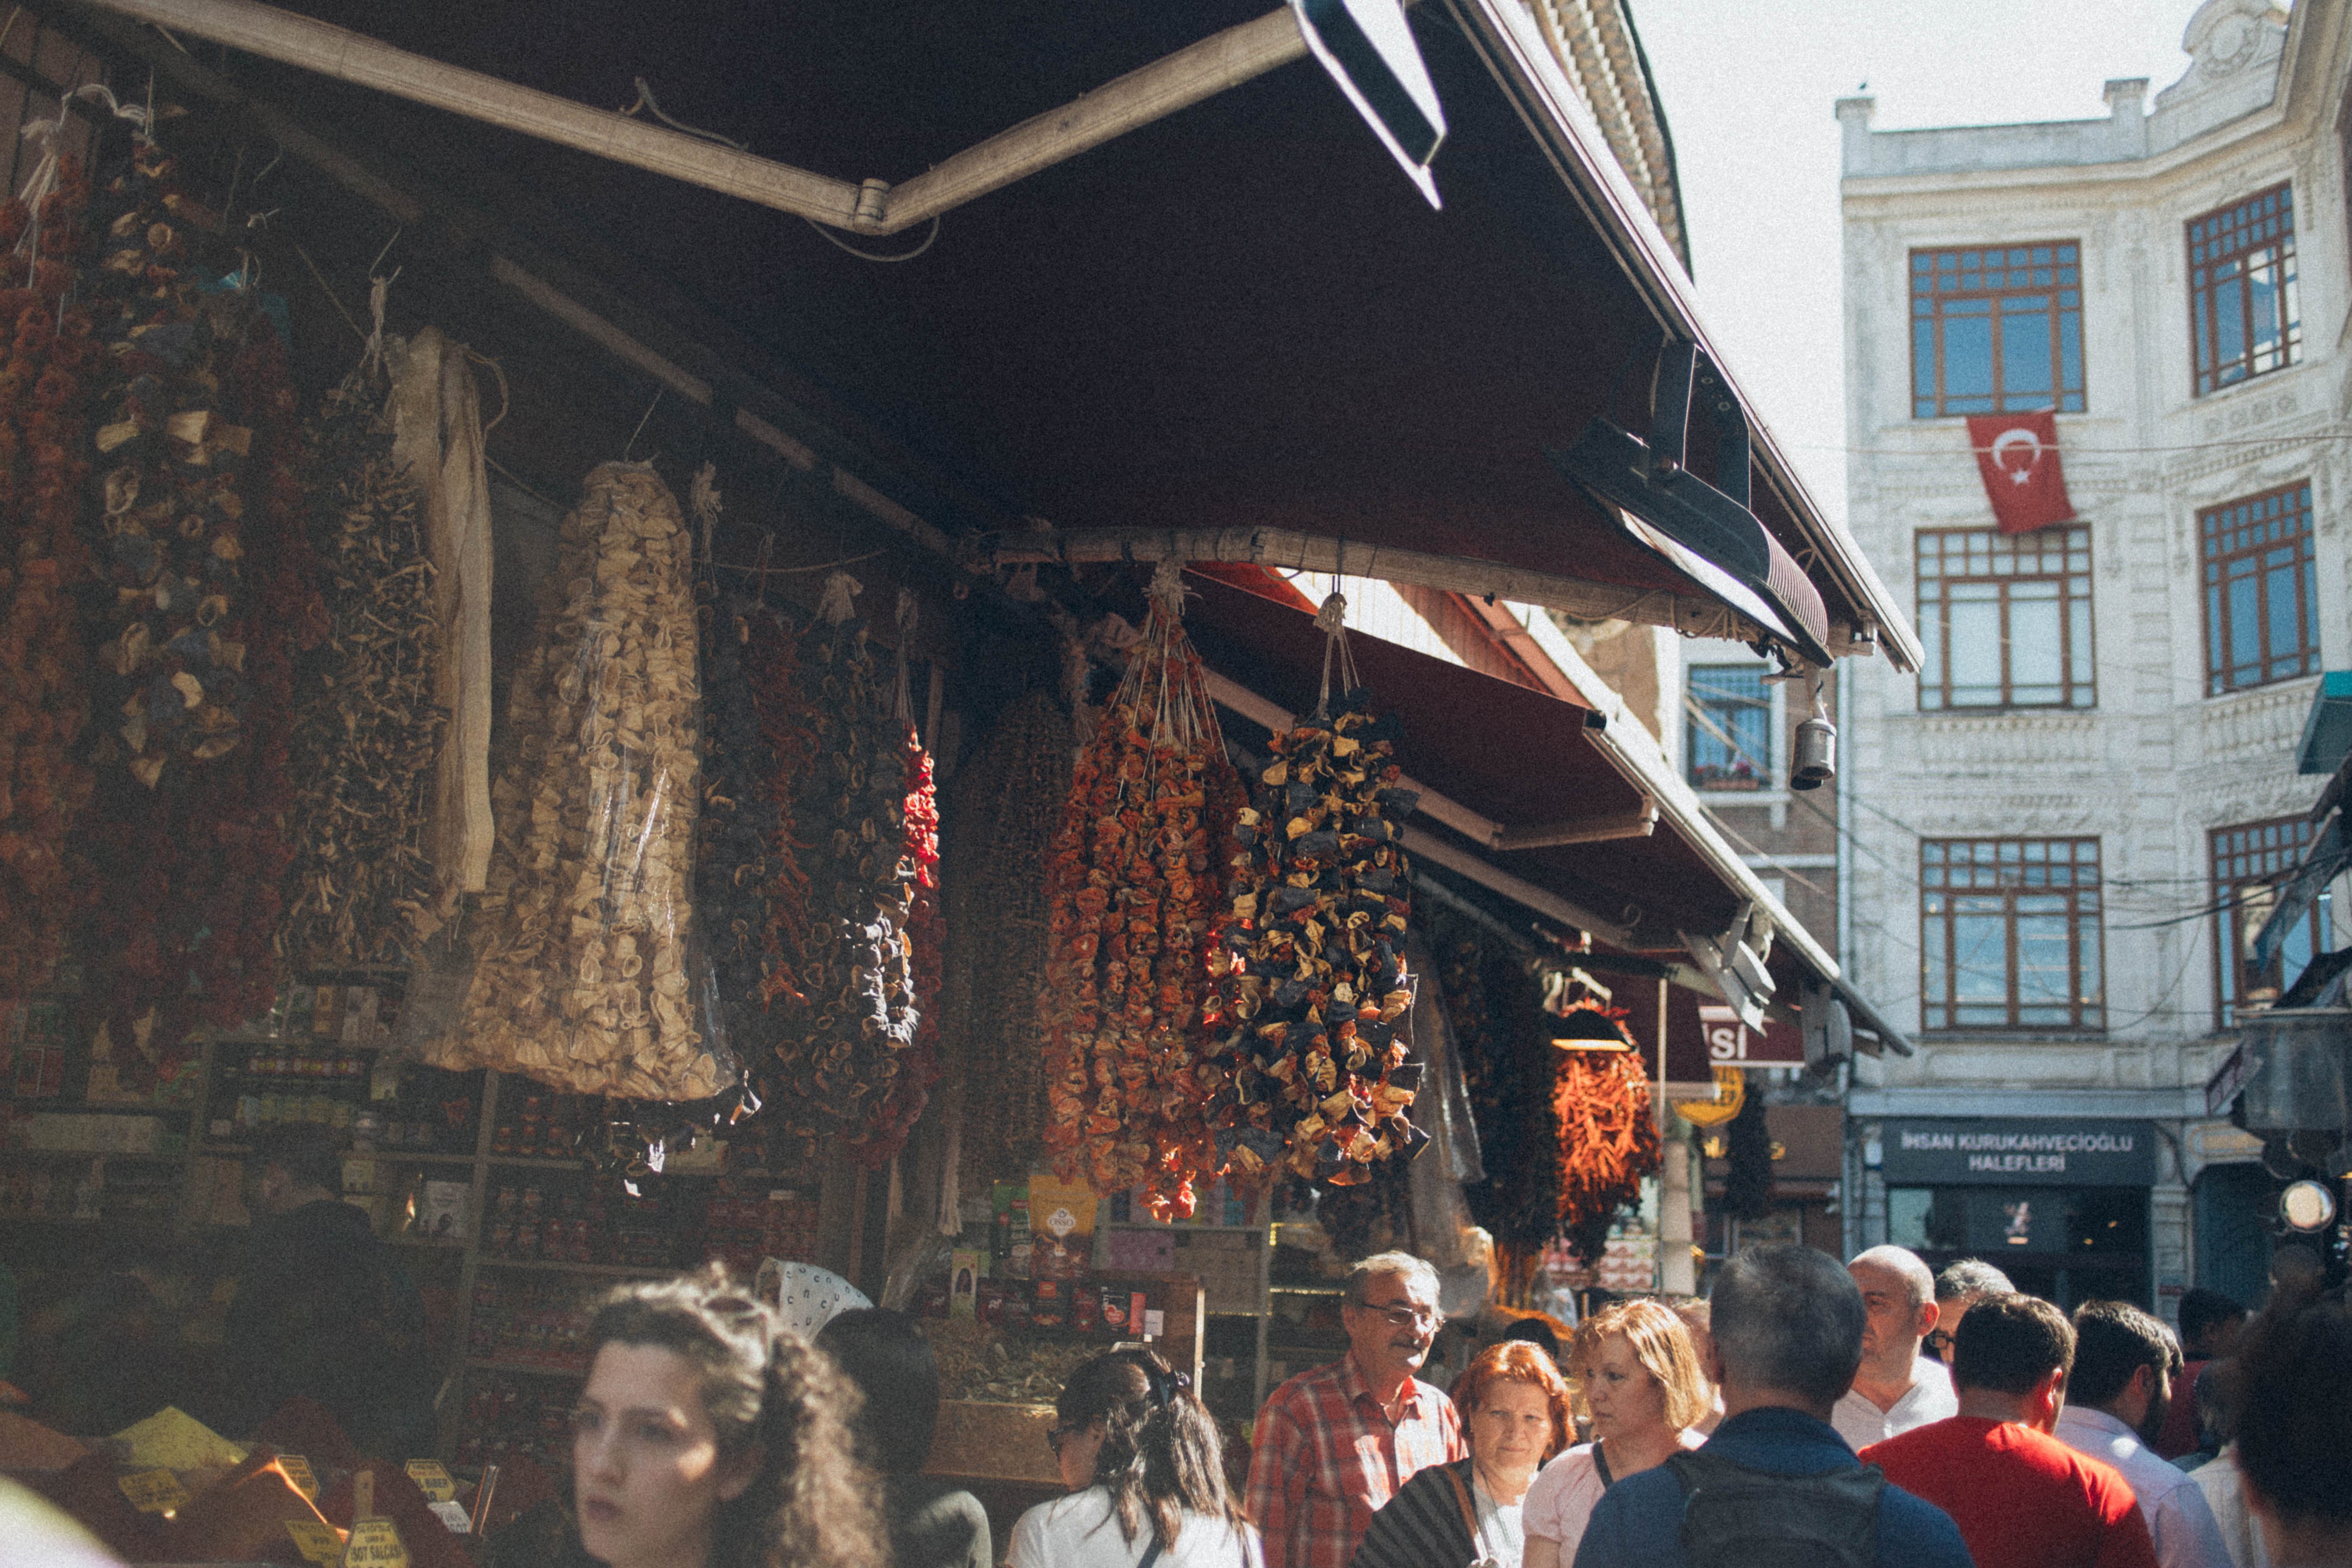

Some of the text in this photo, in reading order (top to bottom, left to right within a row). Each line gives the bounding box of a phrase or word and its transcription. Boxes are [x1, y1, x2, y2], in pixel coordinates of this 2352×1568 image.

[1901, 1130, 2133, 1151] İHSAN KURUKAHVECİOĞLU
[1969, 1152, 2065, 1171] HALEFLERİ
